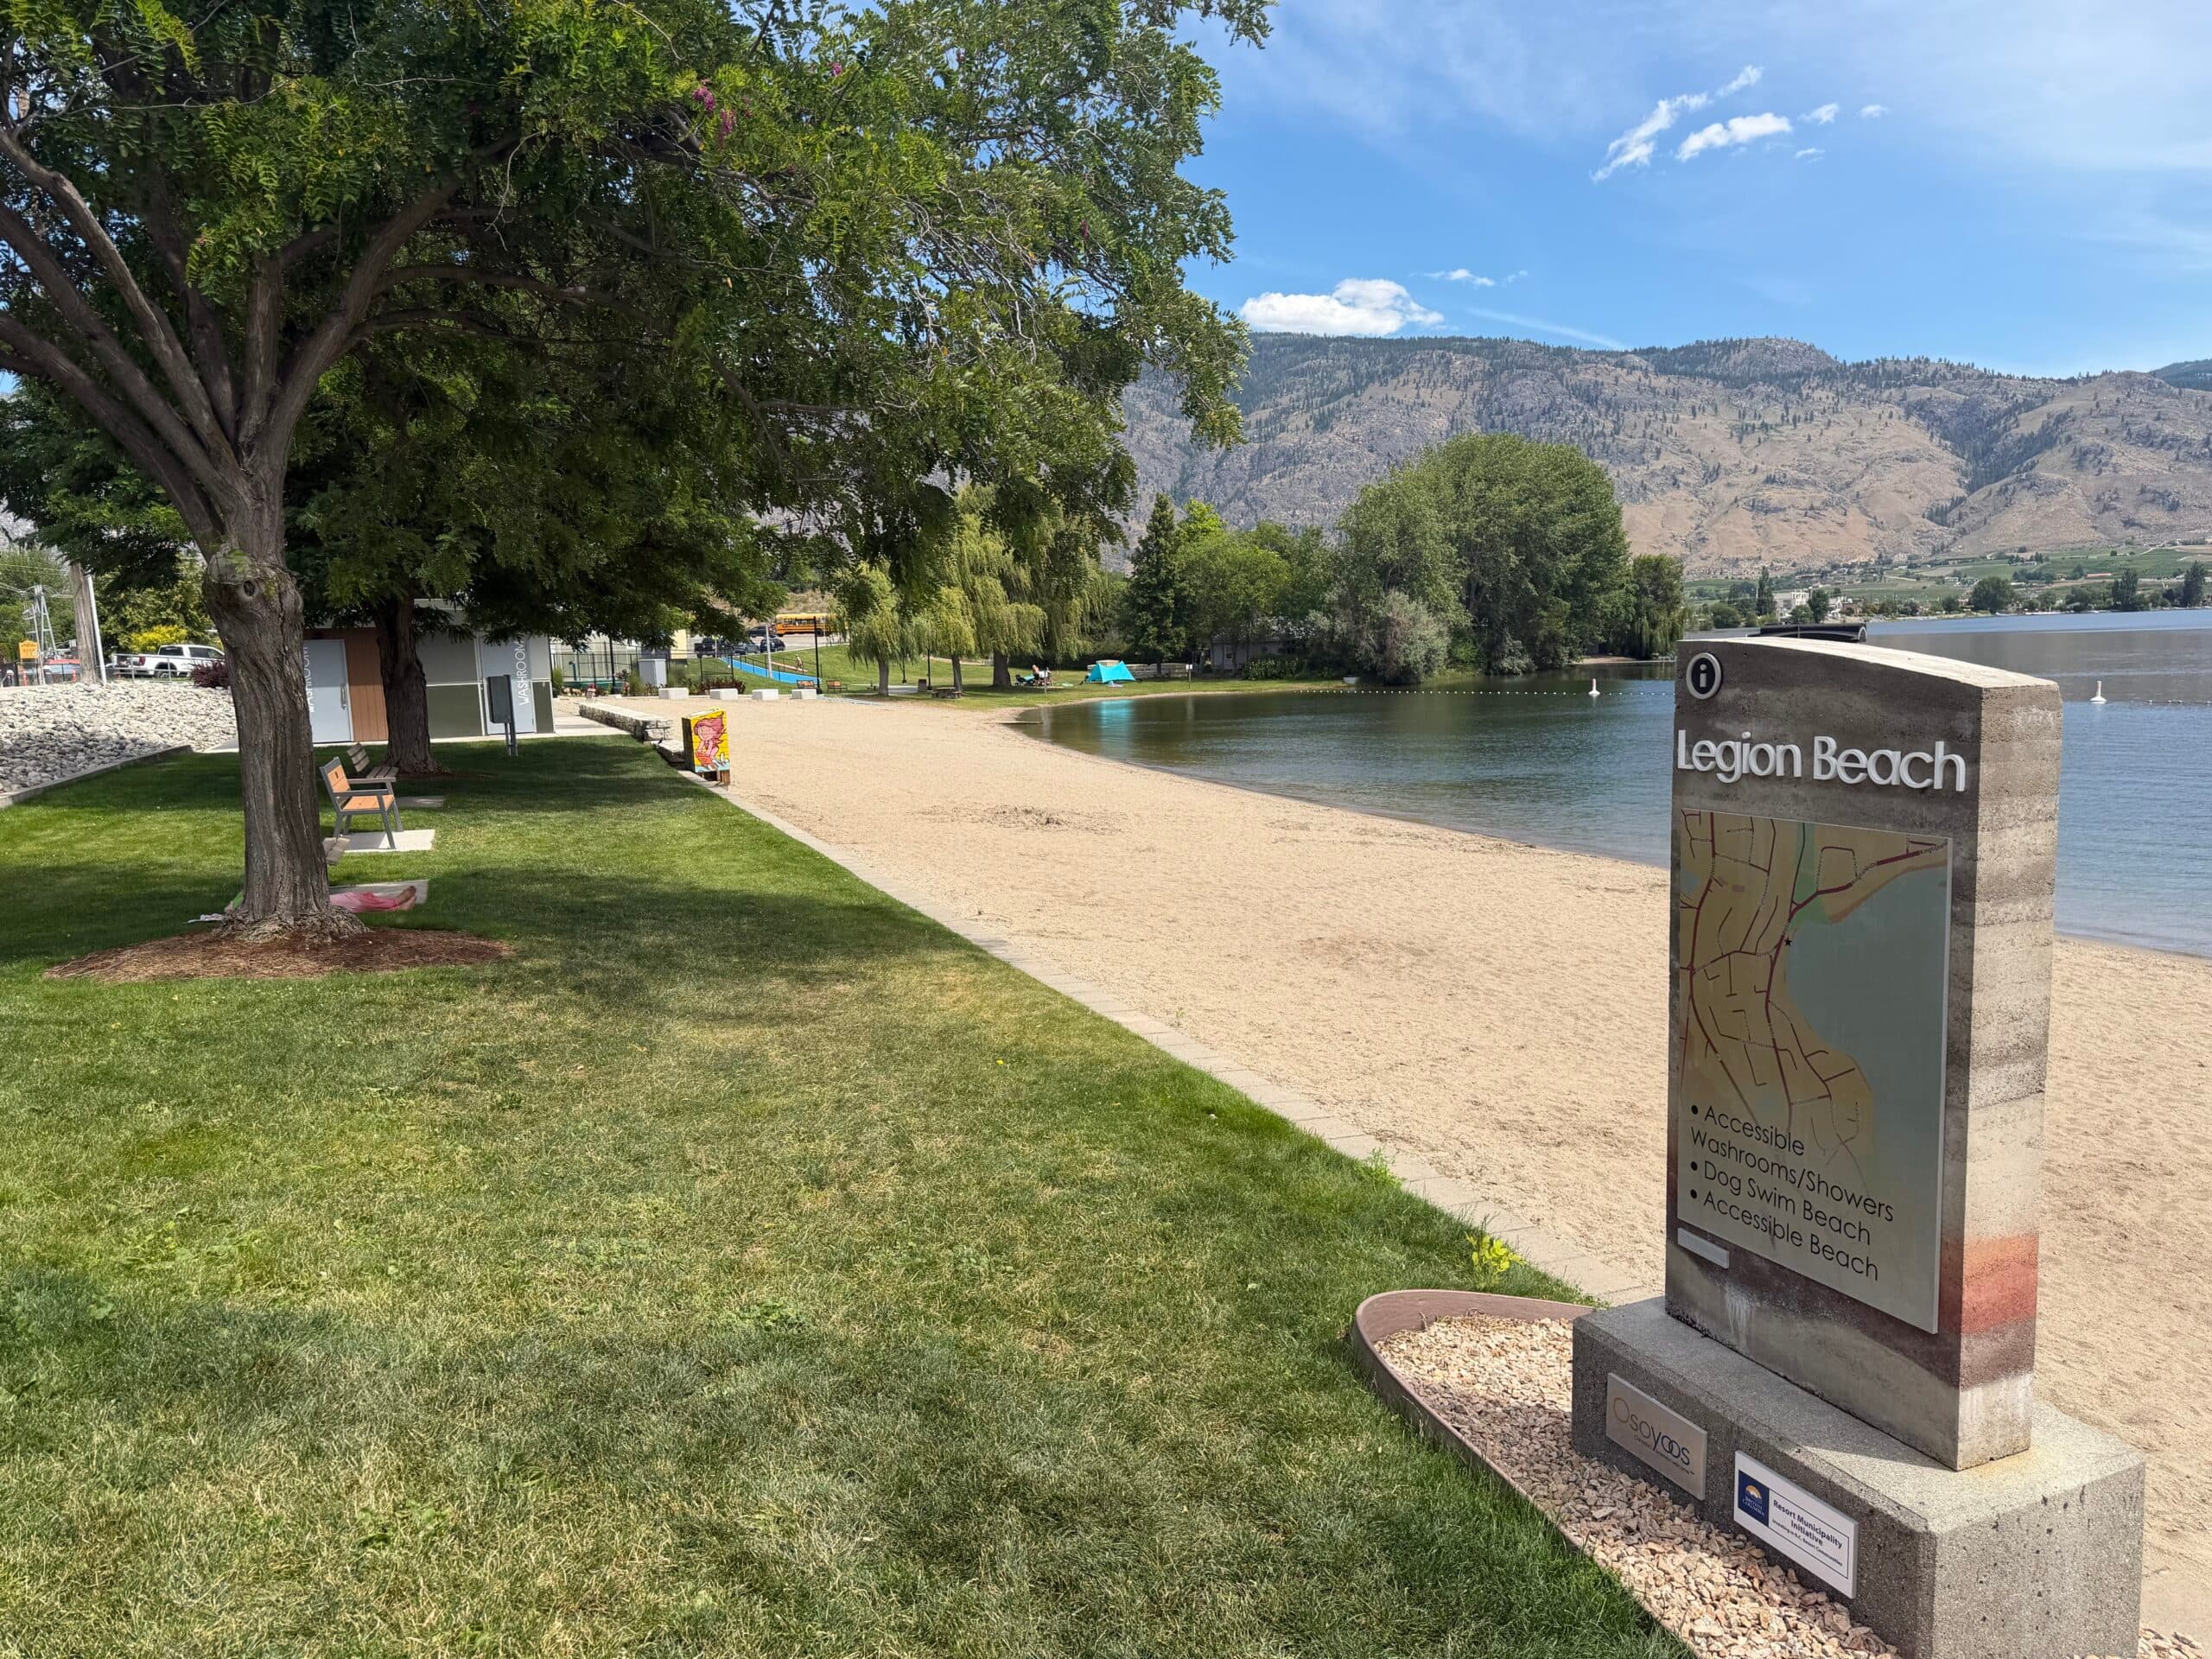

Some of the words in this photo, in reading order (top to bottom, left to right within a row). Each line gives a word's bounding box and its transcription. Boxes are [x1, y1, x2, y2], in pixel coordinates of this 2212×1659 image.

[514, 640, 530, 706] WASHROOM
[1677, 729, 1802, 784] Legion
[1813, 735, 1967, 792] Beach
[1704, 1105, 1805, 1156] Accessible
[1690, 1126, 1894, 1222] Washrooms/Showers
[1704, 1160, 1742, 1196] Dog
[1747, 1178, 1796, 1215] Swim
[1803, 1199, 1871, 1246] Beach
[1703, 1190, 1803, 1247] Accessible
[1810, 1233, 1878, 1281] Beach
[1612, 1397, 1690, 1466] Osoyoos
[1773, 1499, 1796, 1520] Resort
[1796, 1514, 1843, 1549] Municipality
[1790, 1520, 1823, 1546] Initiative
